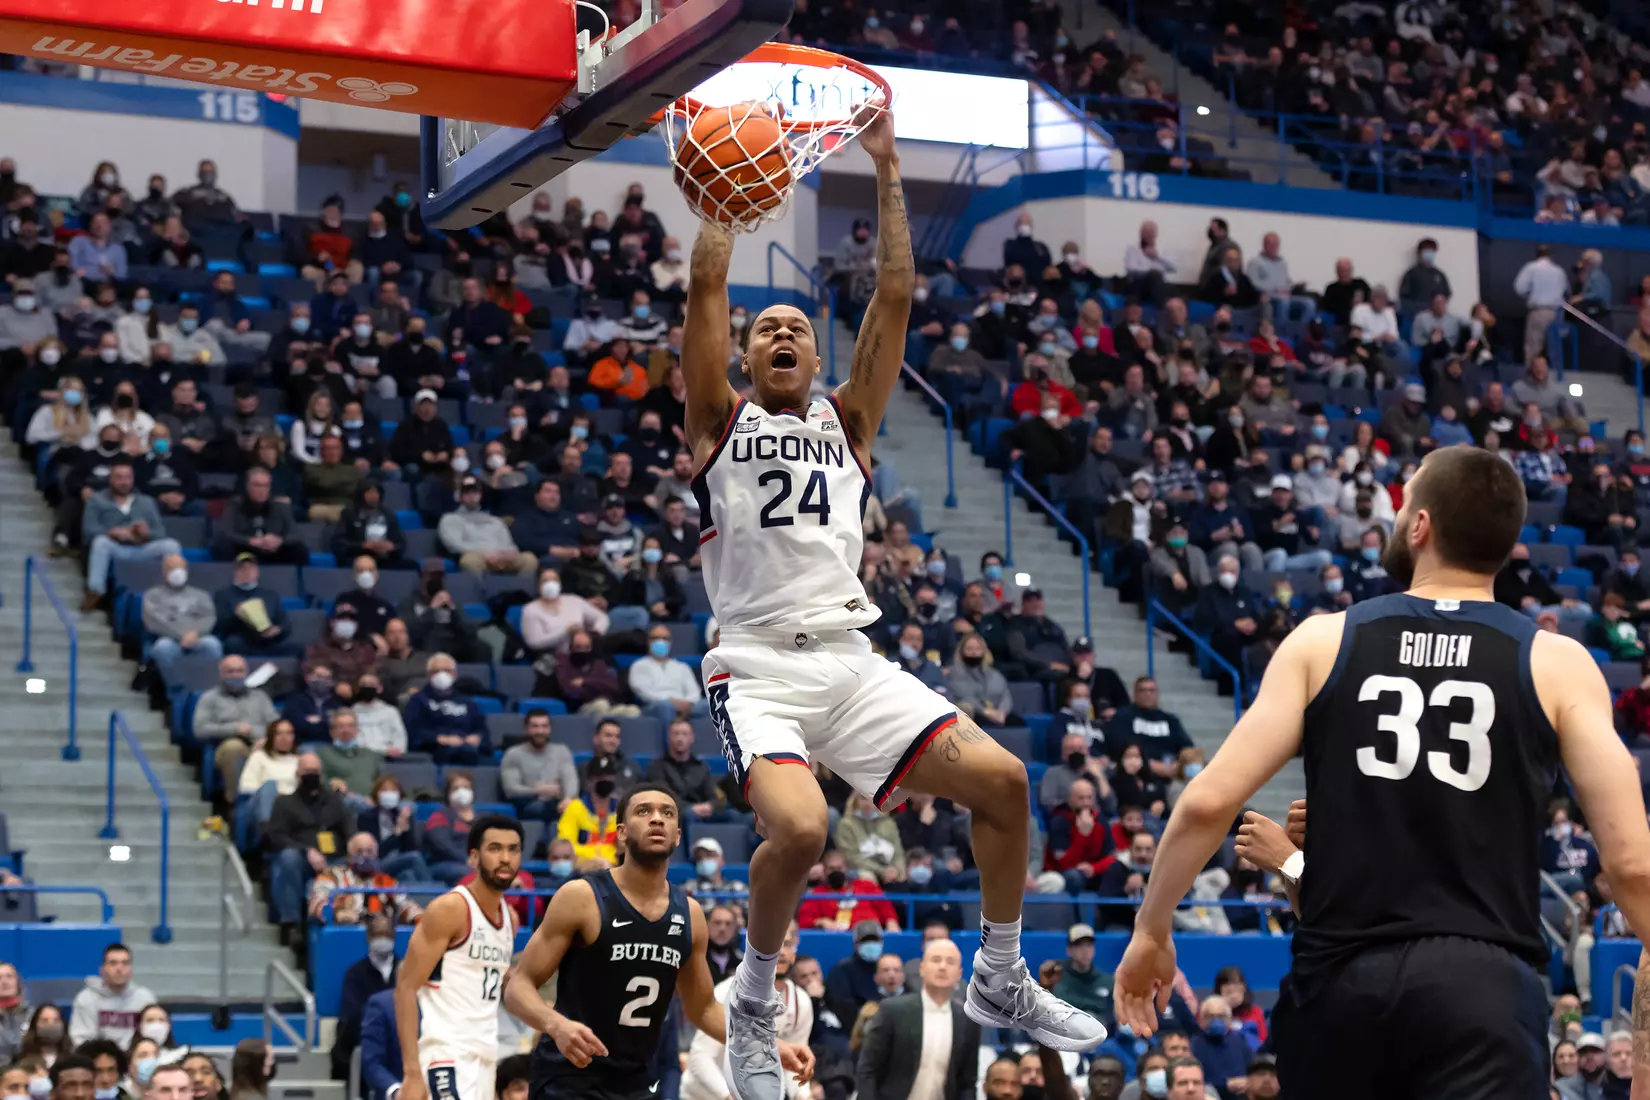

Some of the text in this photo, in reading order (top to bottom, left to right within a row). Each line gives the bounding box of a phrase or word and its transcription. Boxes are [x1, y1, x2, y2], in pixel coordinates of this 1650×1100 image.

[197, 91, 258, 123] 115
[1107, 171, 1161, 200] 116
[732, 434, 844, 468] UCONN
[758, 469, 831, 528] 24
[1399, 630, 1472, 667] GOLDEN
[1356, 674, 1496, 792] 33
[610, 943, 682, 969] BUTLER
[482, 966, 500, 1001] 12
[618, 975, 660, 1027] 2
